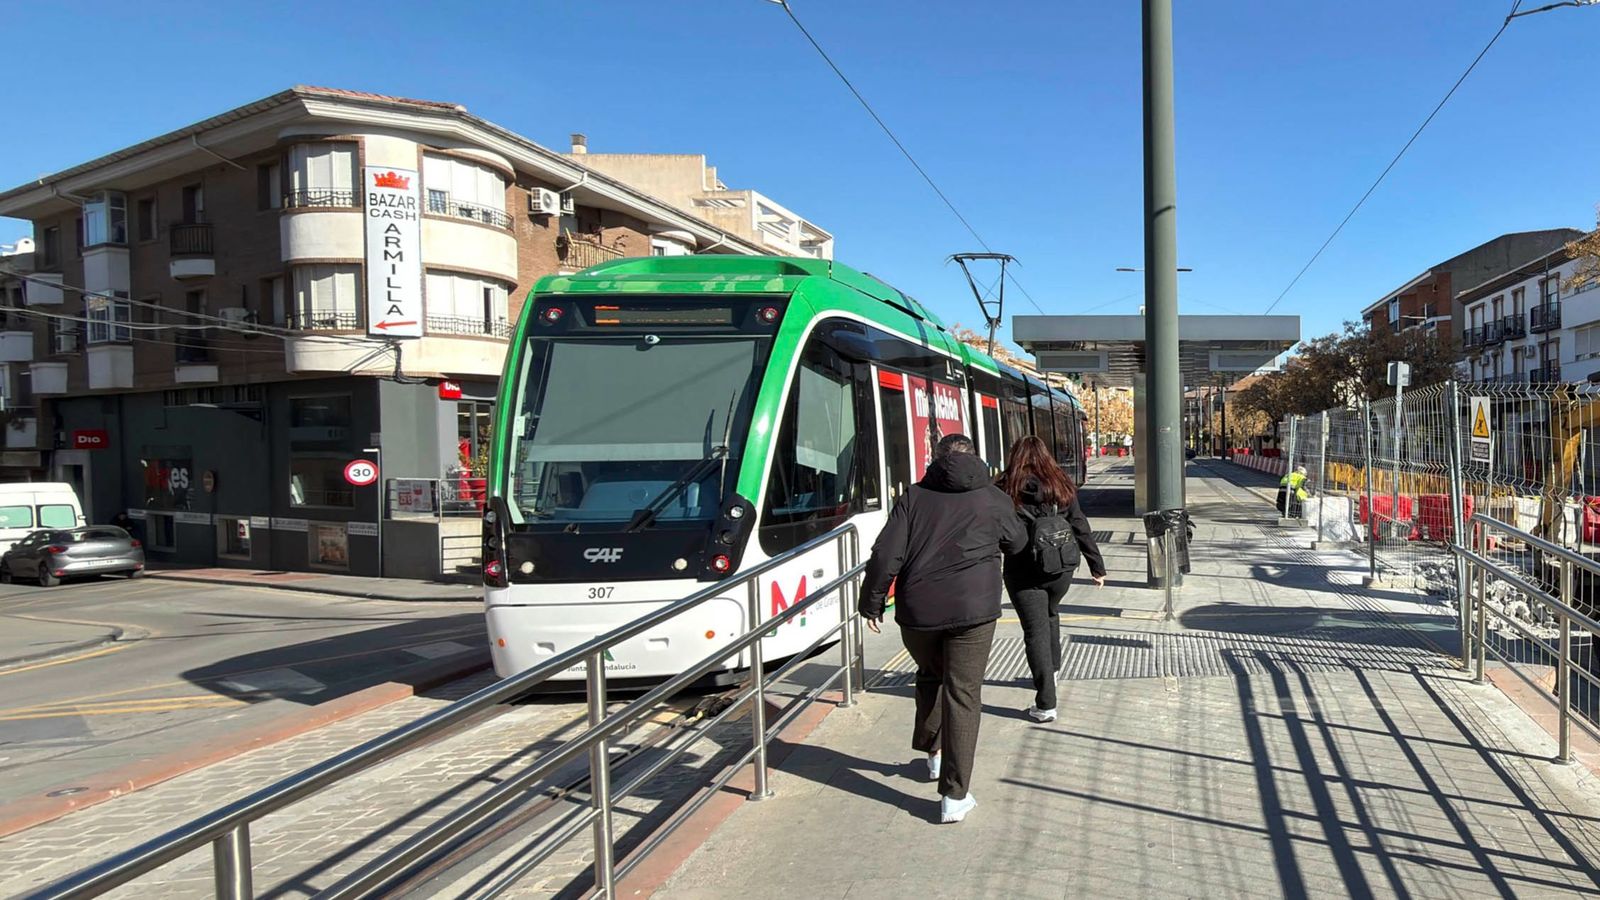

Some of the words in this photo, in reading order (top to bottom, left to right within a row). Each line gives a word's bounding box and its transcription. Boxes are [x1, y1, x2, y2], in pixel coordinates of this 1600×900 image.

[369, 192, 416, 210] BAZAR
[370, 208, 416, 221] CASH
[383, 222, 404, 317] ARMILLA
[352, 468, 371, 477] 30
[583, 548, 624, 563] CAF
[588, 586, 615, 599] 307
[604, 662, 636, 671] ndalucía
